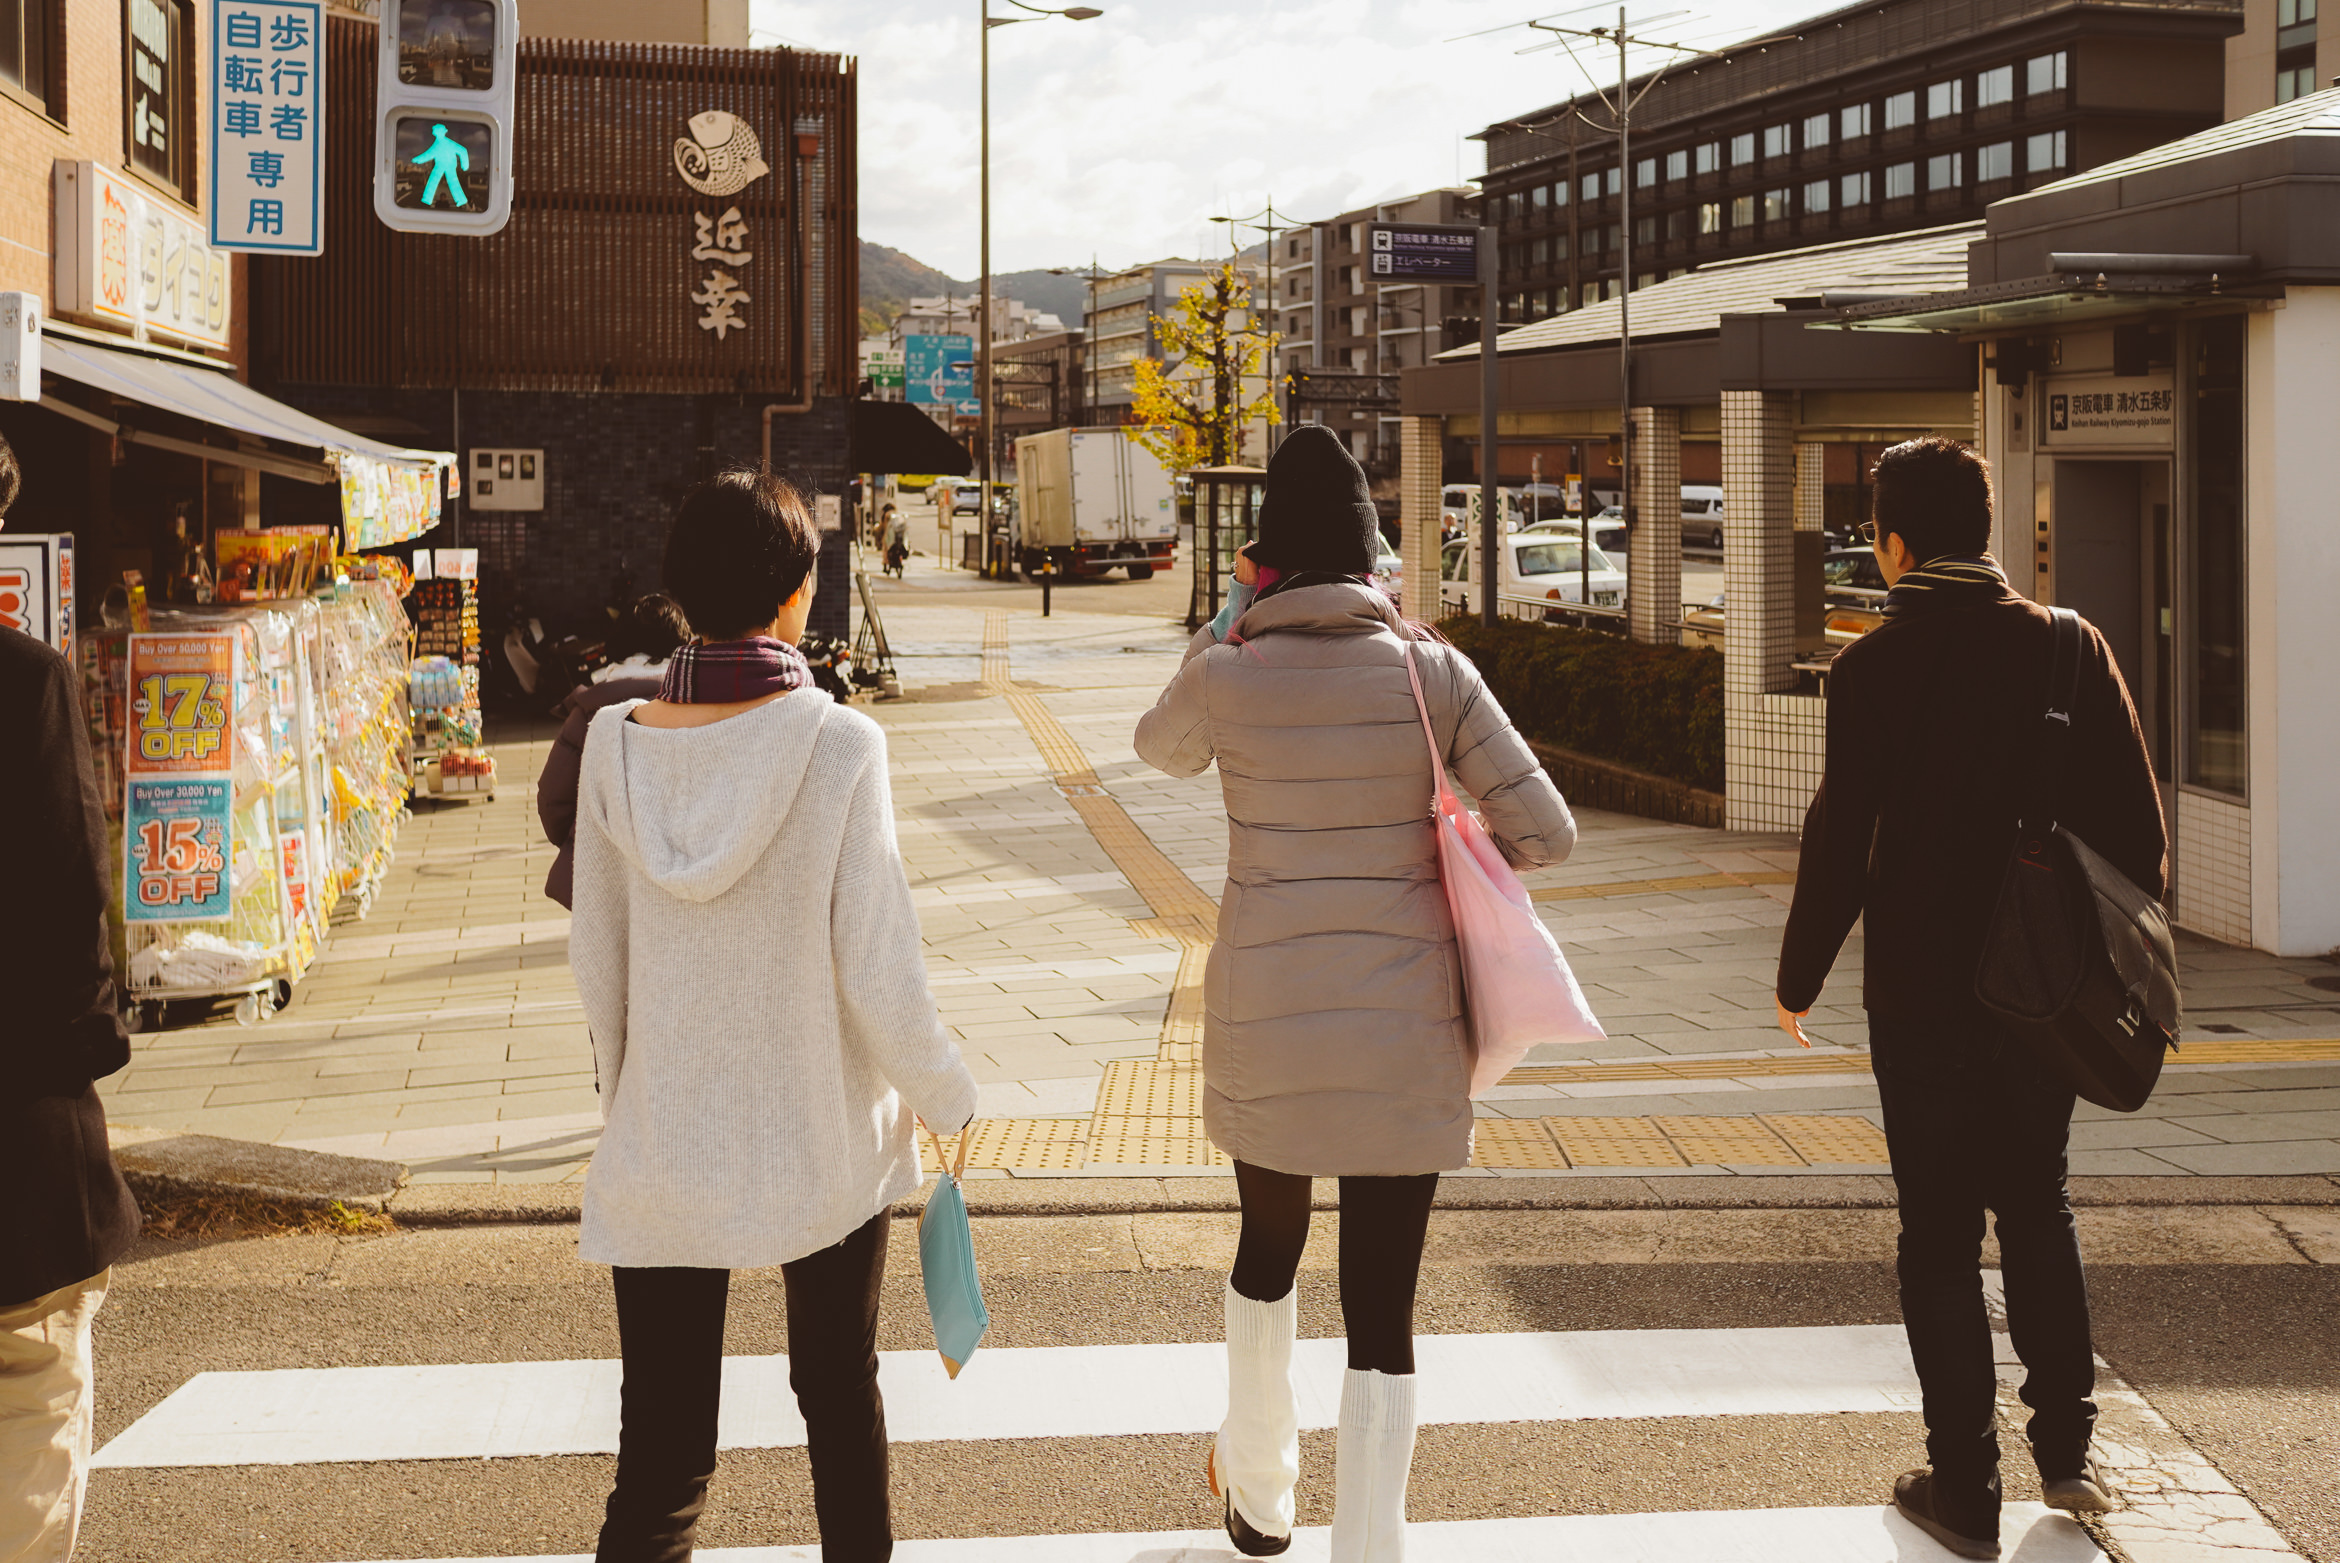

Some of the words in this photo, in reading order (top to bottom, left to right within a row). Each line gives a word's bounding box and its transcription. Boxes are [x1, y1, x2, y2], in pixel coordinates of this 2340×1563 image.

[224, 11, 263, 138] 自転車
[270, 14, 309, 141] 歩行者
[246, 150, 285, 235] 専用
[141, 217, 224, 331] ダイコク
[692, 206, 753, 341] 近幸
[2072, 393, 2113, 415] 京阪電車
[2117, 390, 2172, 413] 清水五条駅
[2151, 416, 2171, 426] Station
[139, 643, 155, 656] Buy
[157, 643, 177, 655] Over
[209, 642, 225, 654] Yen
[142, 729, 220, 760] OFF
[136, 787, 153, 800] Buy
[154, 787, 174, 798] Over
[177, 785, 204, 798] 30,000
[207, 784, 223, 797] Yen
[140, 874, 218, 905] OFF
